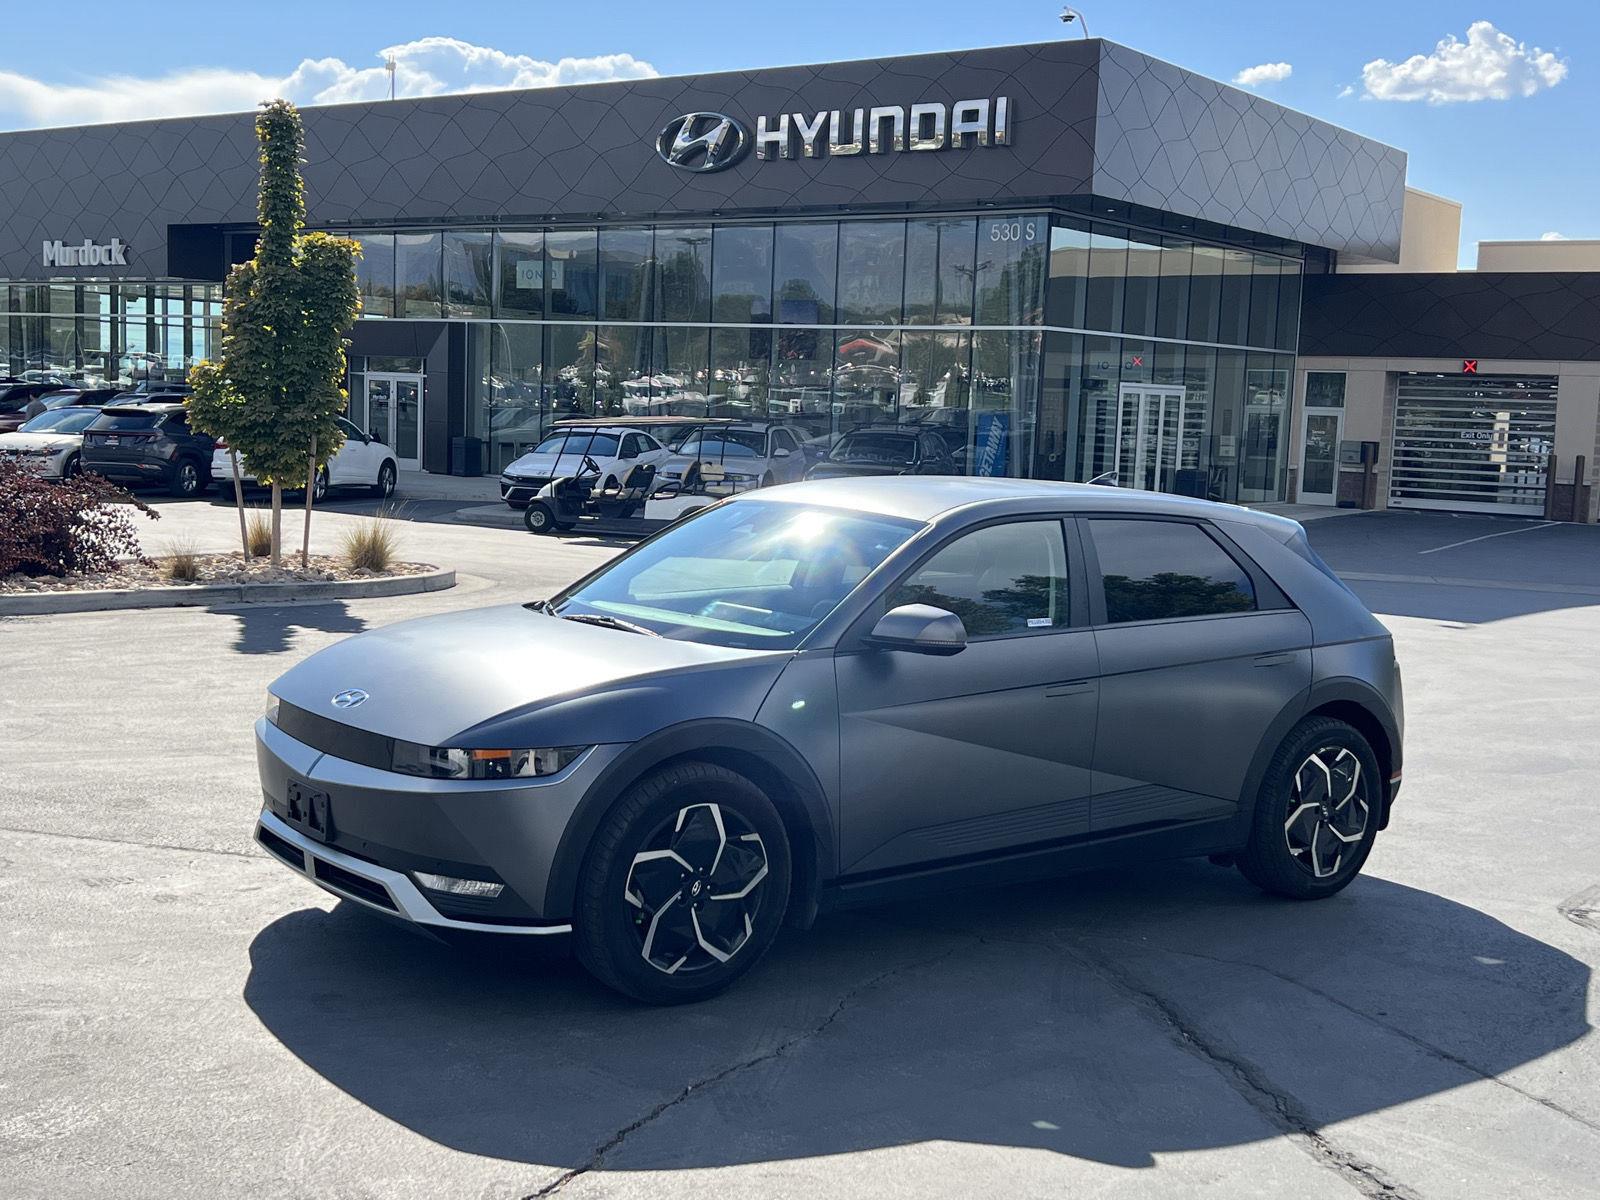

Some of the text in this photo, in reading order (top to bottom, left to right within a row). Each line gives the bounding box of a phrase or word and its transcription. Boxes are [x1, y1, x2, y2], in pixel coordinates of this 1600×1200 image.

[757, 96, 1011, 160] HYUNDAI
[990, 222, 1035, 241] 530 S
[43, 237, 127, 266] Murdock
[522, 269, 557, 280] IONQ
[1476, 432, 1493, 440] Only
